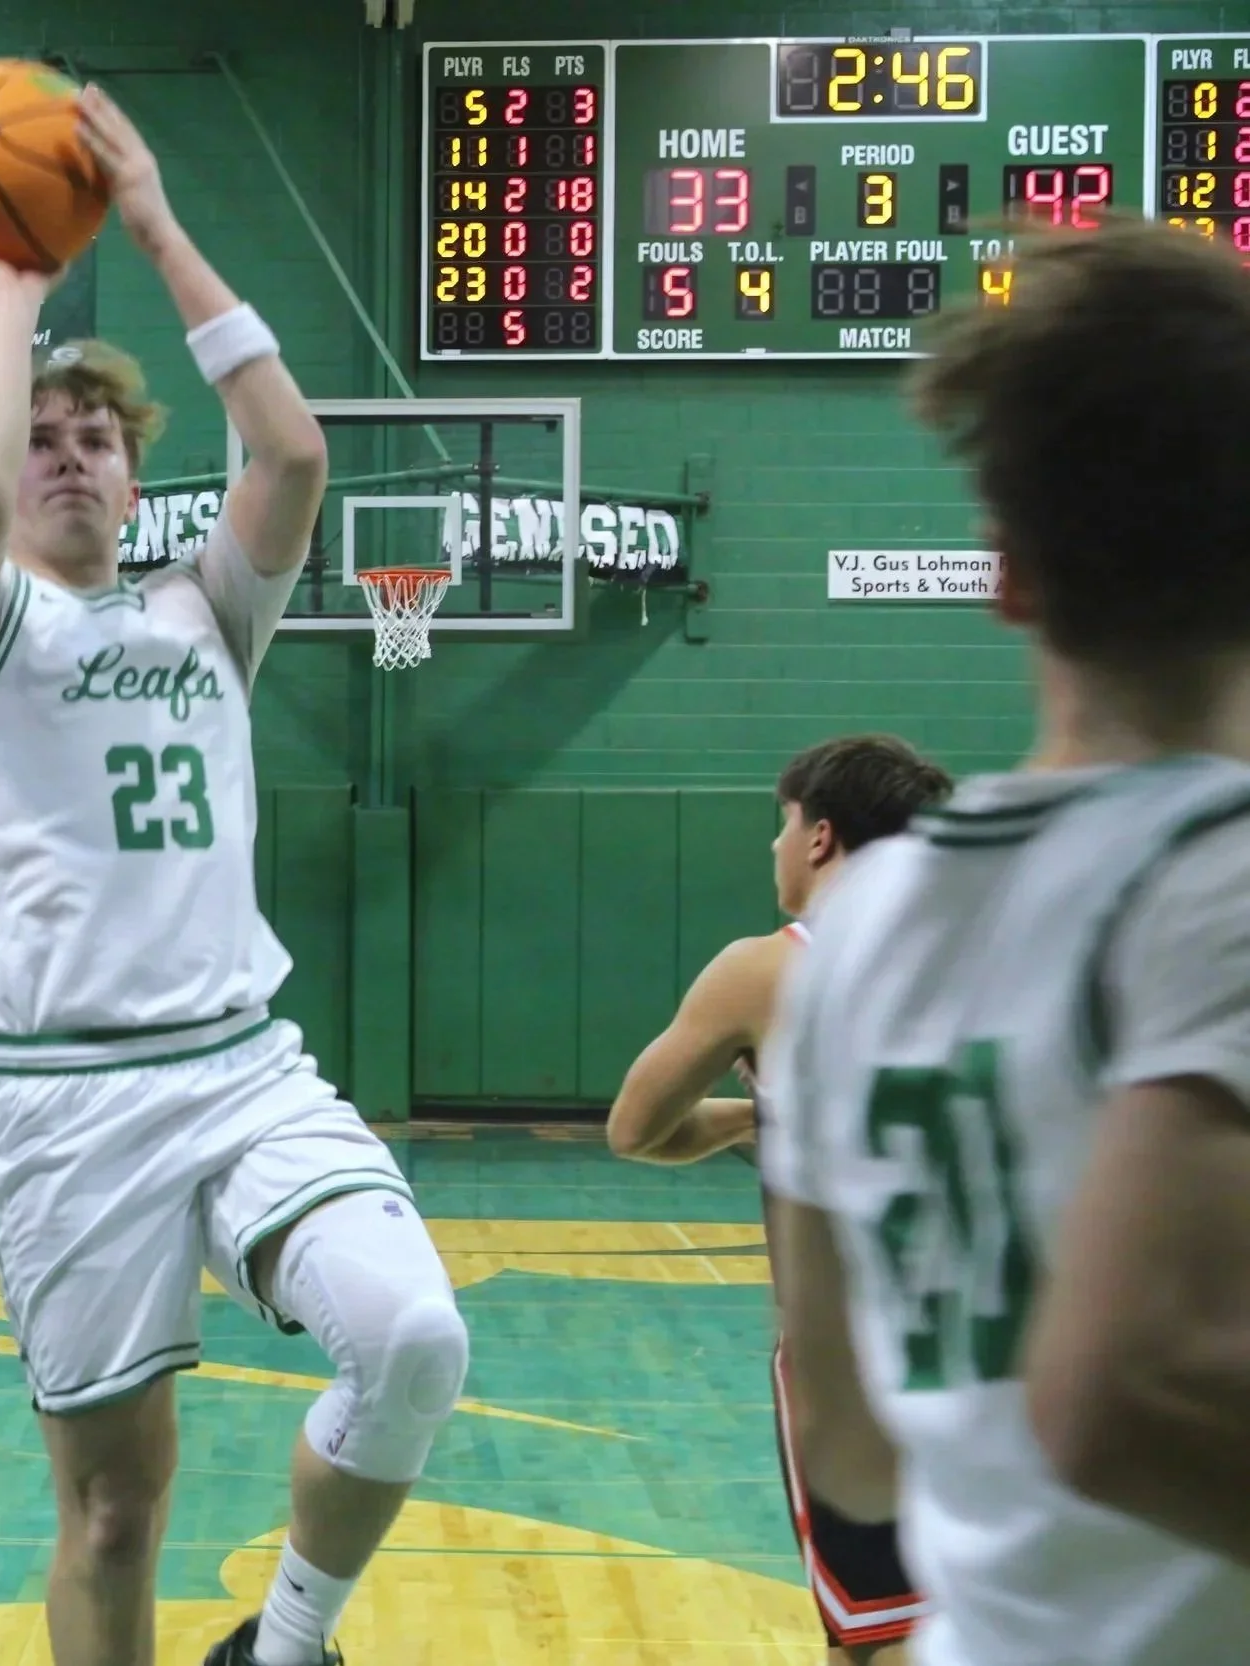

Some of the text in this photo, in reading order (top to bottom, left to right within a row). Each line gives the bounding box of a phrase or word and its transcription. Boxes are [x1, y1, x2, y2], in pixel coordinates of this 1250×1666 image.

[444, 55, 585, 77] PLYR FLS PTS
[1172, 48, 1250, 70] PLYR FL
[828, 47, 975, 112] 2:46
[465, 88, 594, 125] 5 2 3
[1194, 82, 1217, 118] 0
[452, 135, 593, 167] 11 1 1
[659, 128, 746, 159] HOME
[841, 145, 915, 166] PERIOD
[1008, 124, 1109, 156] GUEST
[1207, 130, 1216, 160] 1
[452, 177, 592, 212] 14 2 18
[669, 169, 749, 233] 33
[865, 174, 893, 225] 3
[1025, 165, 1108, 229] 42
[1179, 172, 1216, 209] 12
[437, 221, 592, 257] 20 0 0
[637, 241, 704, 263] FOULS
[728, 241, 785, 263] T.O.L.
[810, 241, 888, 262] PLAYER
[896, 240, 948, 262] FOUL
[436, 265, 592, 301] 23 0 2
[663, 267, 693, 317] 5
[740, 271, 770, 313] 4
[983, 271, 1012, 307] 4
[503, 310, 525, 345] 5
[637, 327, 703, 350] SCORE
[839, 327, 911, 349] MATCH
[835, 555, 865, 571] V.J.
[873, 555, 909, 571] Gus
[917, 555, 991, 571] Lohman
[852, 577, 910, 596] Sports
[917, 578, 930, 593] &
[937, 577, 988, 593] Youth
[62, 643, 224, 722] Leafs
[105, 744, 215, 851] 23
